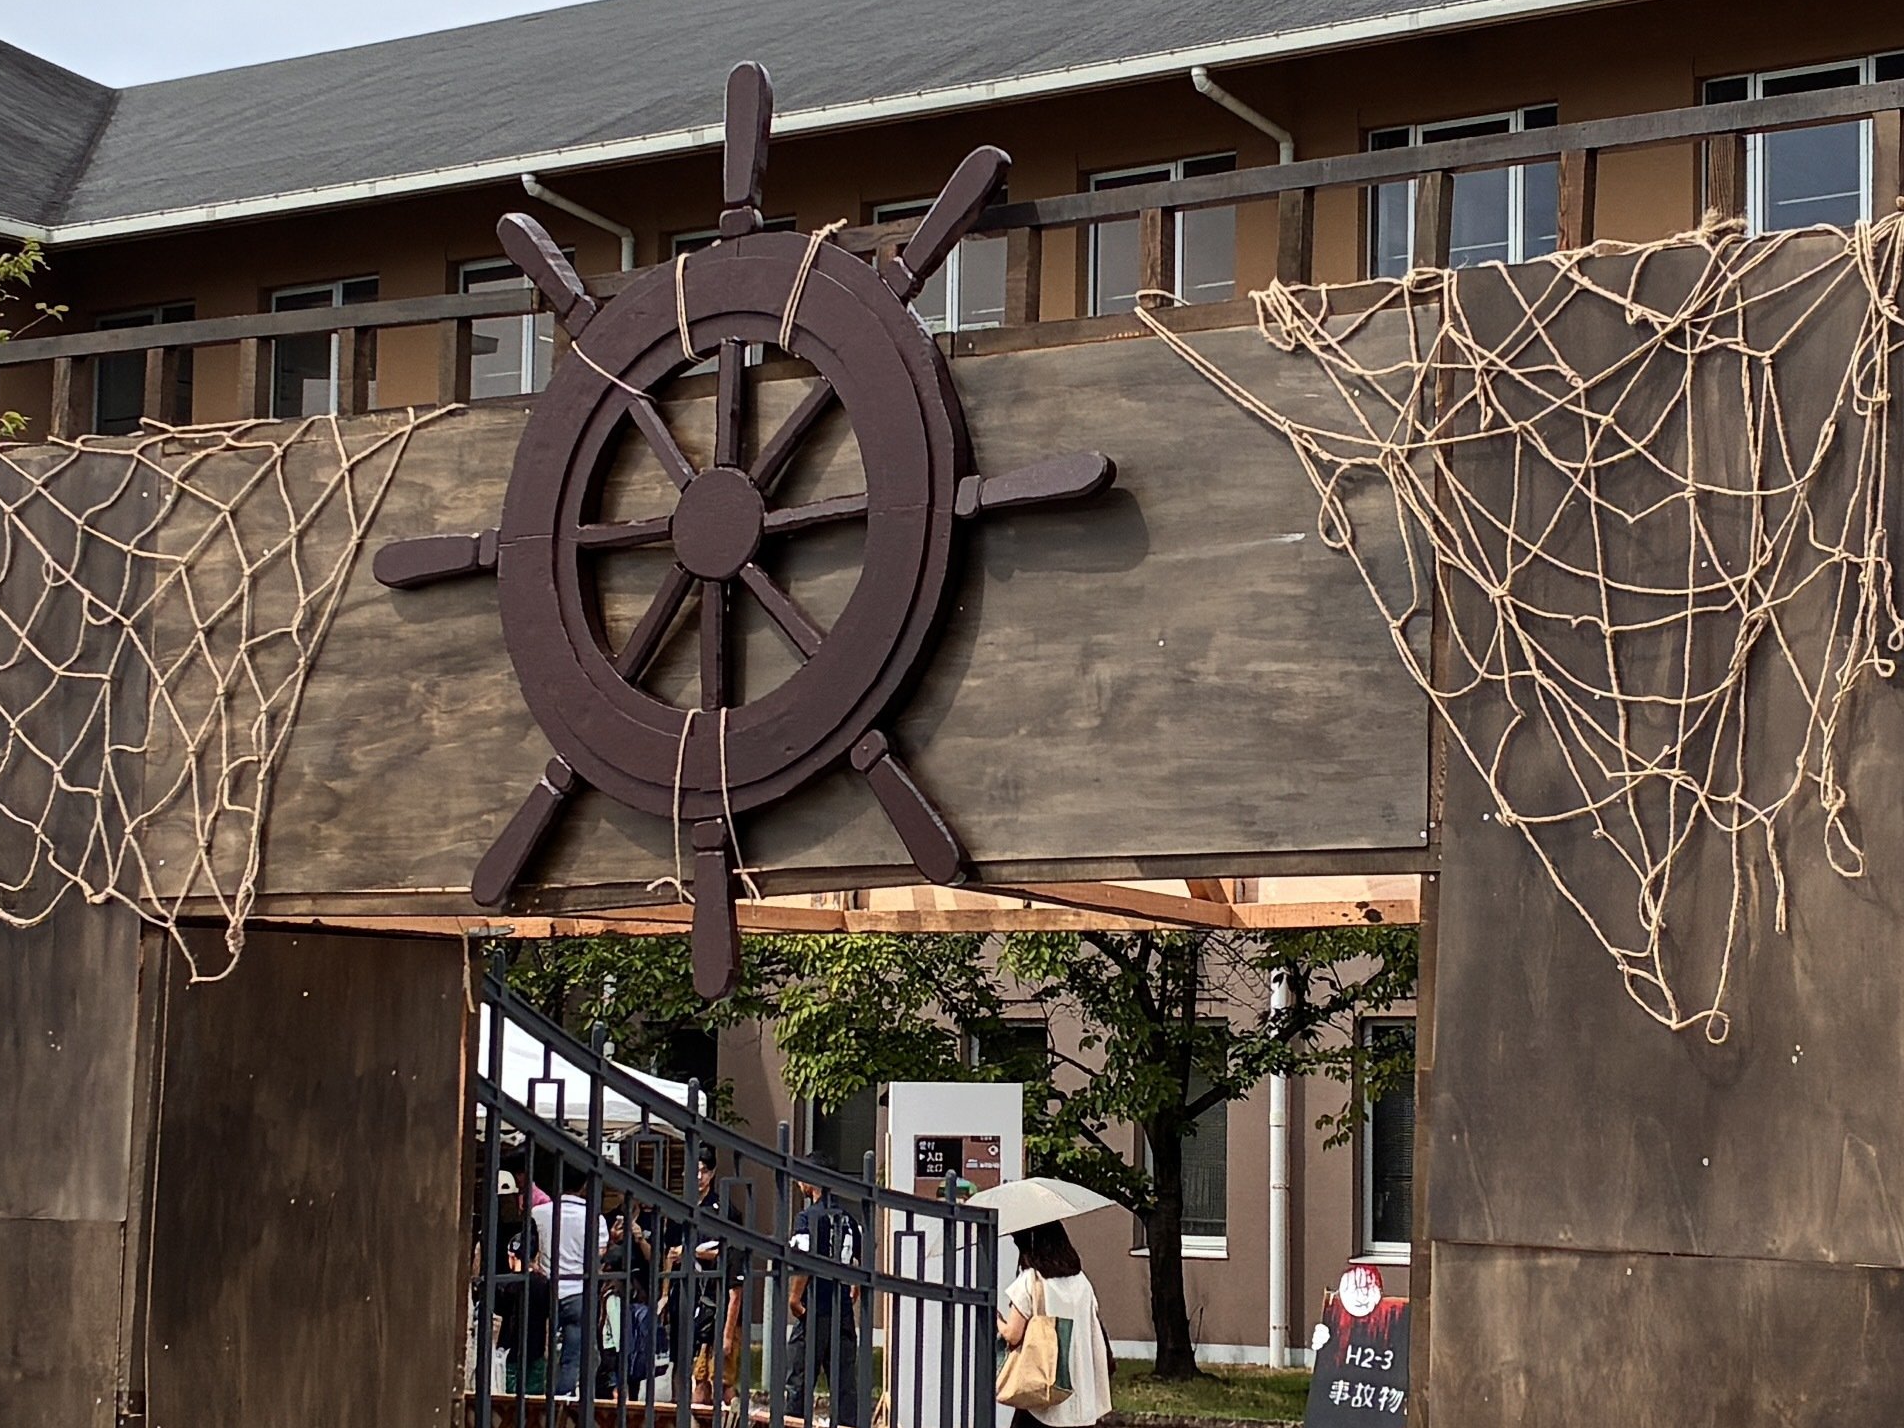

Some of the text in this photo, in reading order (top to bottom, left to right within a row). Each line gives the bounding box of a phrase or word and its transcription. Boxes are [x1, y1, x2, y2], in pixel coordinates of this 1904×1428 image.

[927, 1152, 943, 1162] 入口
[1345, 1344, 1394, 1370] H2-3
[1329, 1379, 1408, 1415] 事故物
